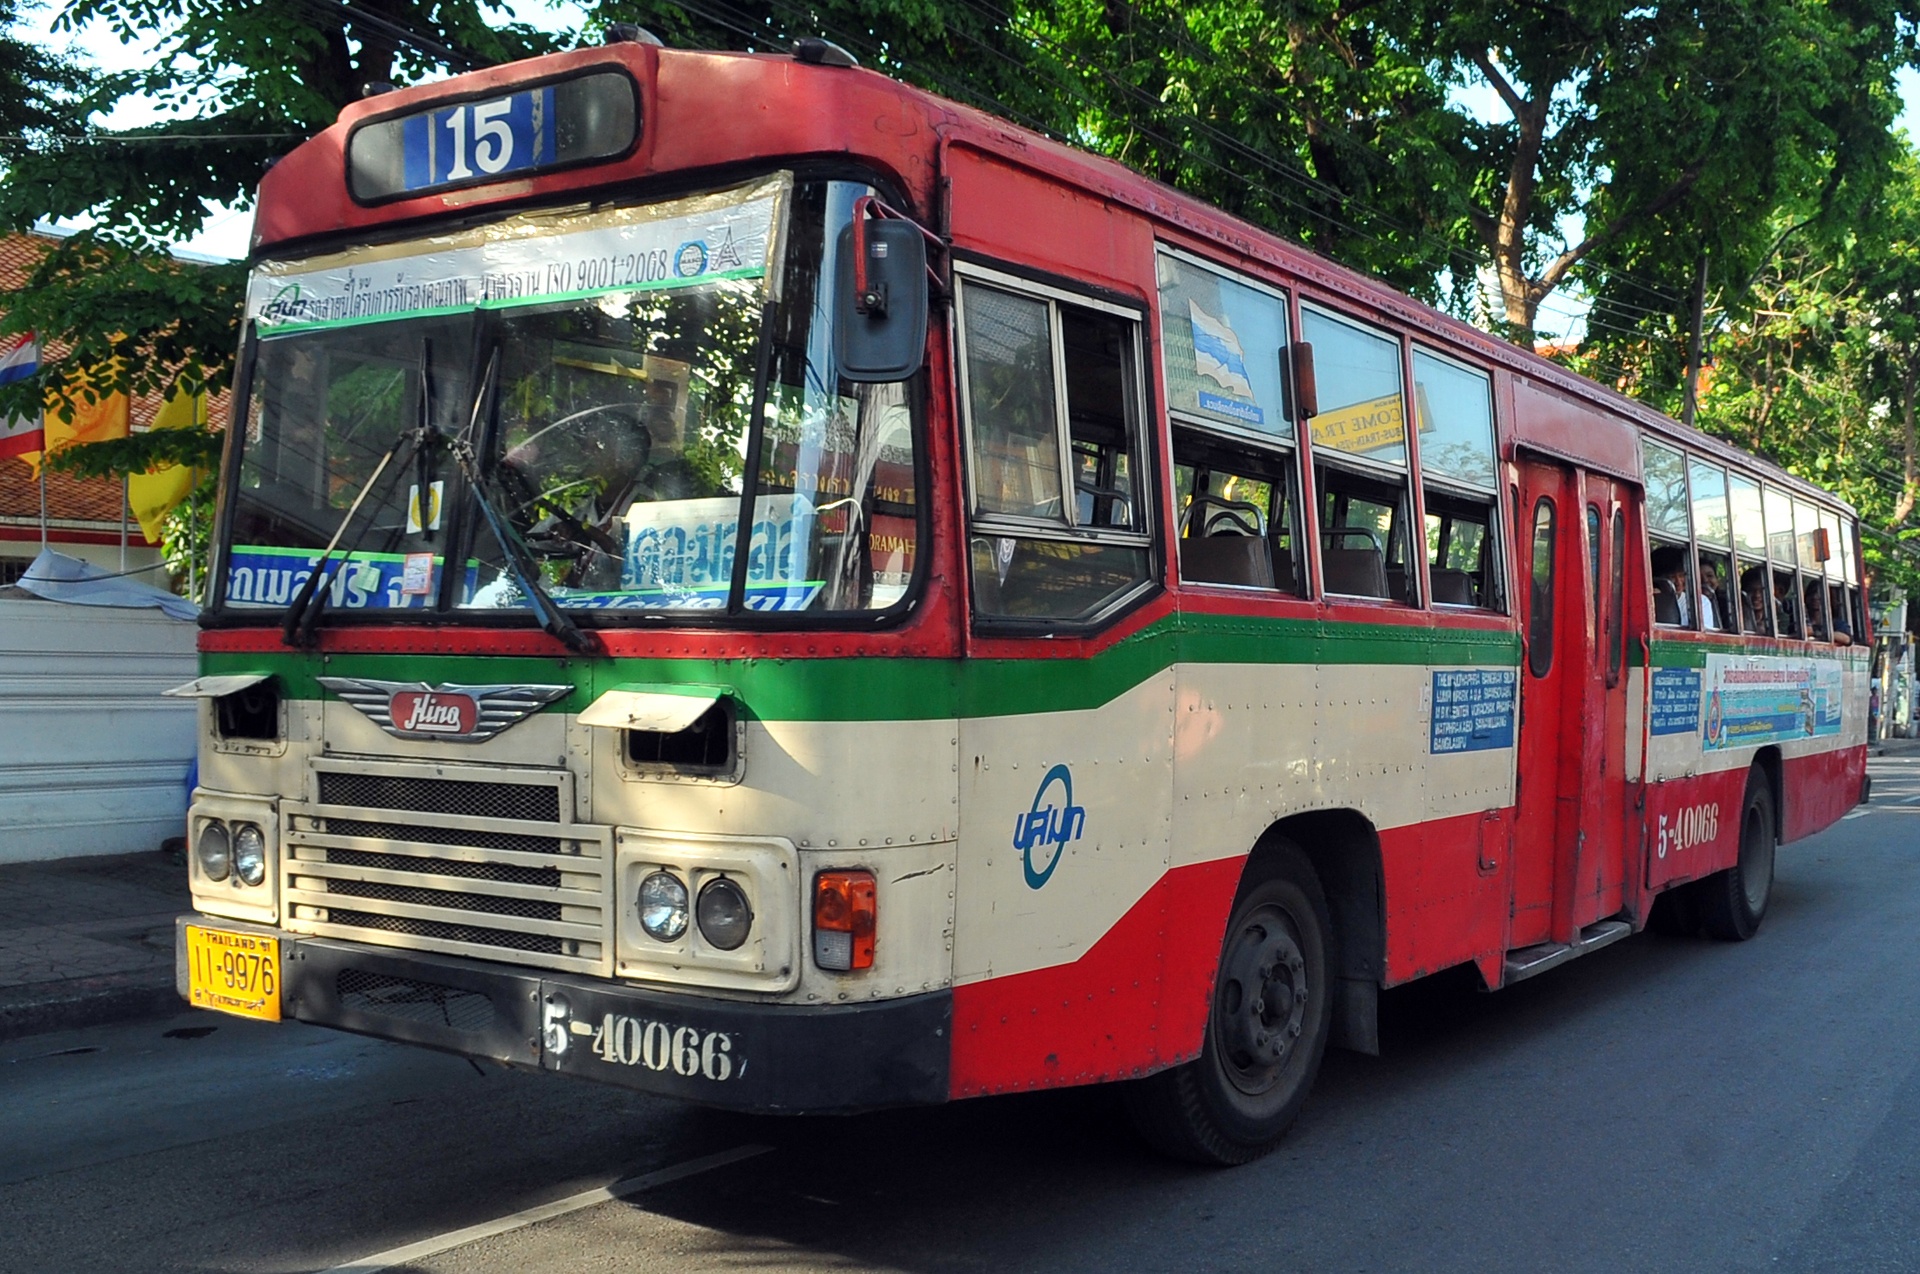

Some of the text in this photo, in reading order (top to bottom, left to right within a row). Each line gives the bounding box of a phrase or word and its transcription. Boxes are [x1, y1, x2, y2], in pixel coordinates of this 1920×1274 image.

[446, 96, 513, 180] 15
[547, 261, 571, 296] ISO
[577, 250, 668, 291] 9001:2008
[404, 693, 460, 731] Hino
[1658, 802, 1718, 859] 5-40066
[206, 932, 256, 950] THAILAND
[195, 945, 275, 996] 11-9976
[543, 1002, 731, 1081] 5-40066
